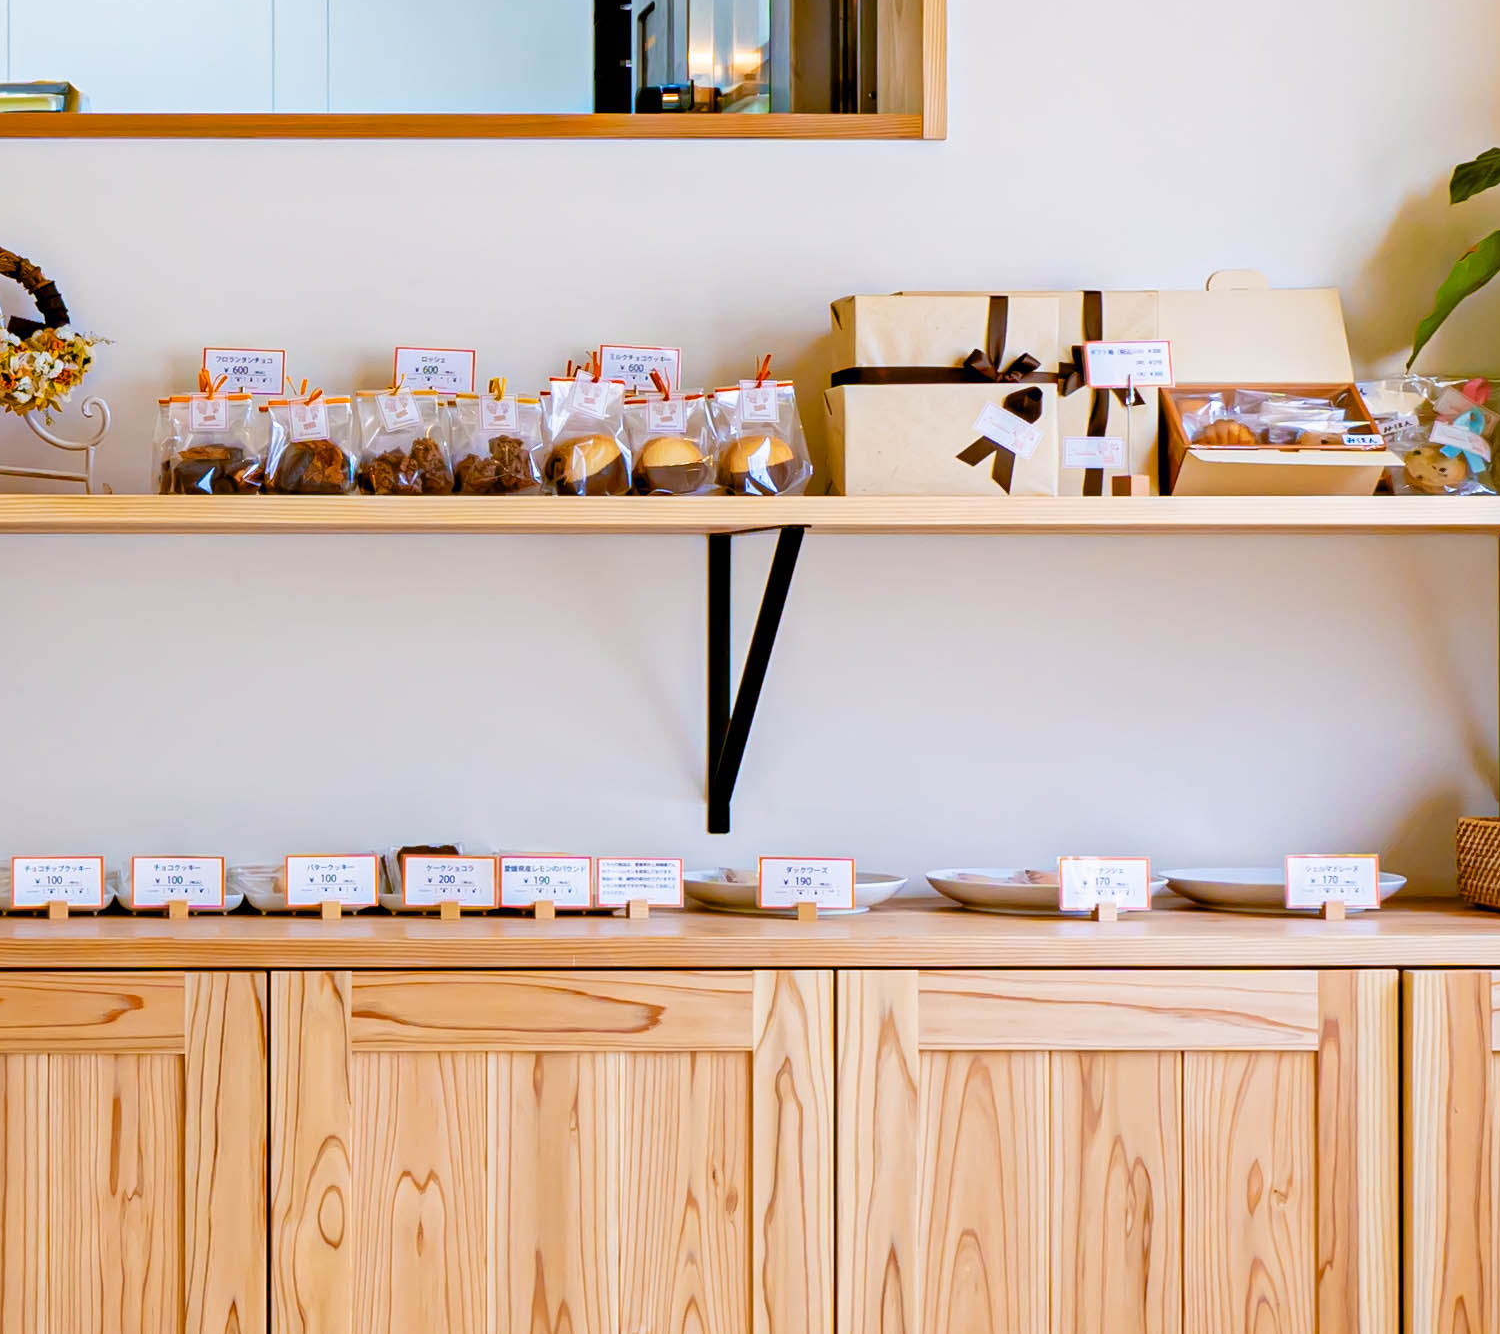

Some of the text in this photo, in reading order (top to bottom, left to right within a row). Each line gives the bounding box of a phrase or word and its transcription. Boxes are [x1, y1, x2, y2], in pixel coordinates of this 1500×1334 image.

[215, 356, 273, 364] フロランタンチョコ
[421, 355, 446, 364] ロッシェ
[232, 365, 249, 375] 600
[422, 365, 439, 375] 600
[628, 364, 644, 373] 600
[24, 865, 92, 873] チョコチップクッキー
[153, 863, 201, 872] チョコクッキー
[306, 863, 355, 872] バタークッキー
[46, 875, 63, 885] 100
[167, 875, 184, 885] 100
[320, 874, 337, 883] 100
[438, 875, 456, 884] 200
[533, 876, 551, 885] 190
[795, 877, 812, 886] 190
[1322, 875, 1339, 885] 170
